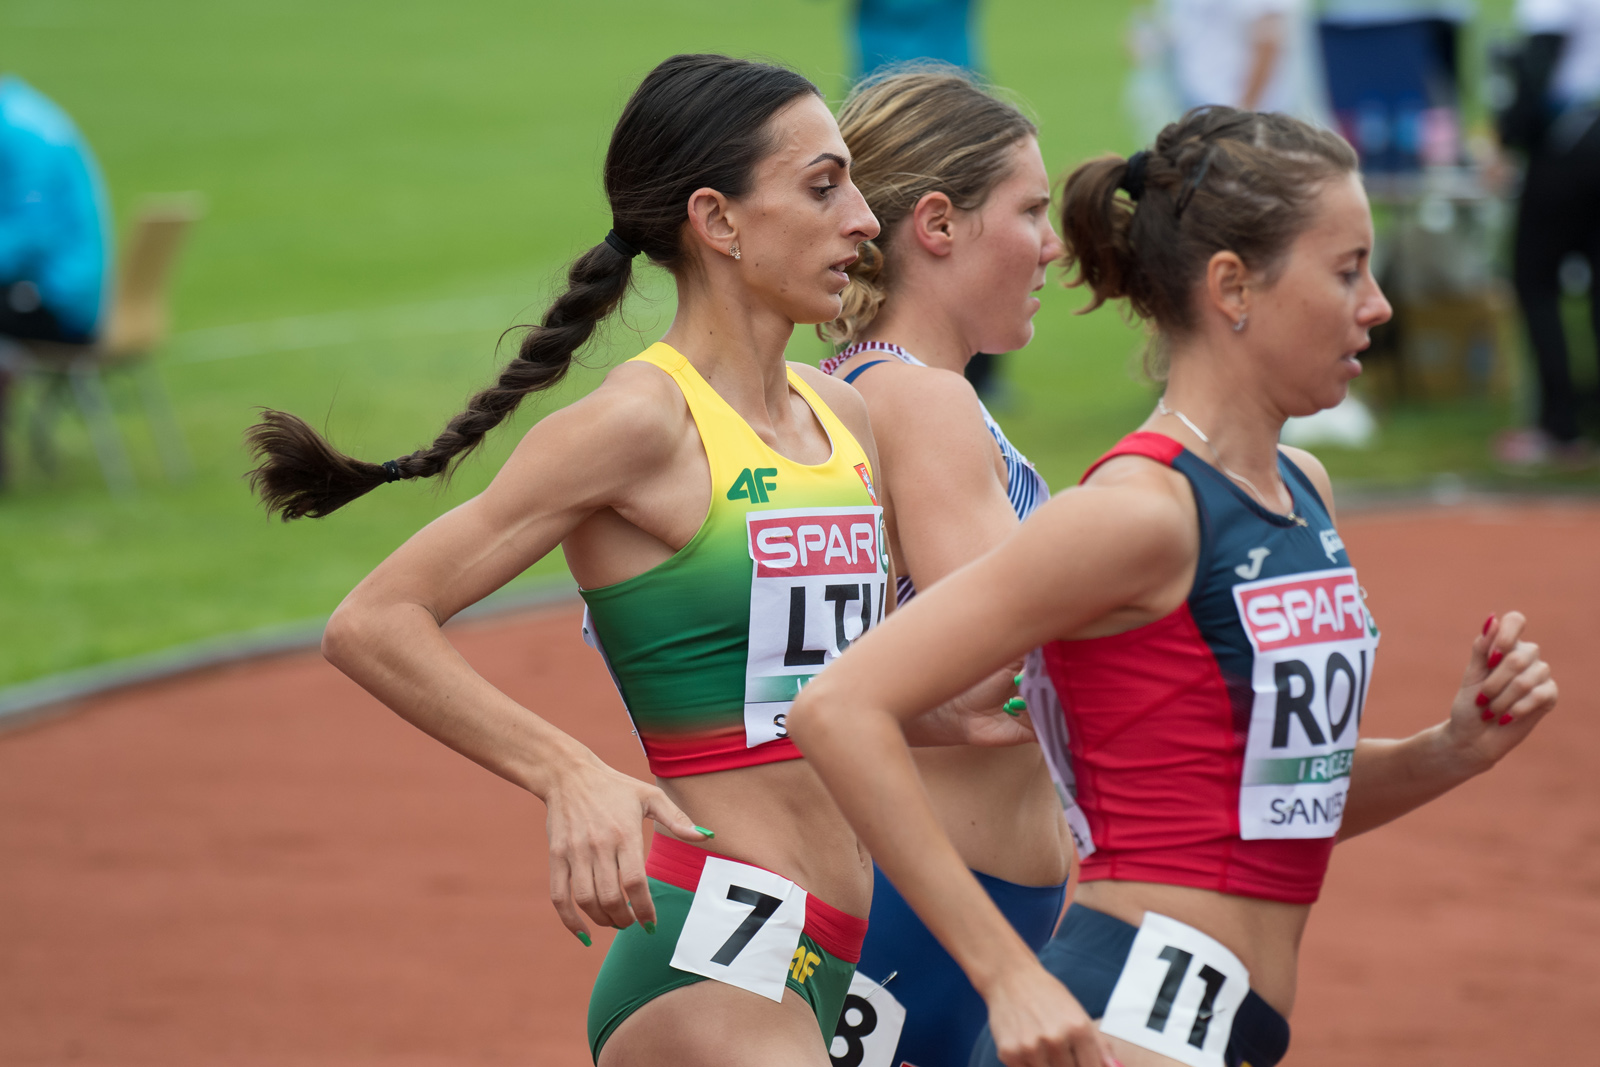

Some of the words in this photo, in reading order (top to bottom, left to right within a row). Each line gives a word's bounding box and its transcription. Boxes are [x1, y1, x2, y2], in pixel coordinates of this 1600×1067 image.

[727, 468, 777, 504] 4F
[757, 522, 875, 569] SPAR
[1247, 583, 1362, 643] SPAR
[710, 884, 783, 967] 7
[1146, 945, 1227, 1051] 11
